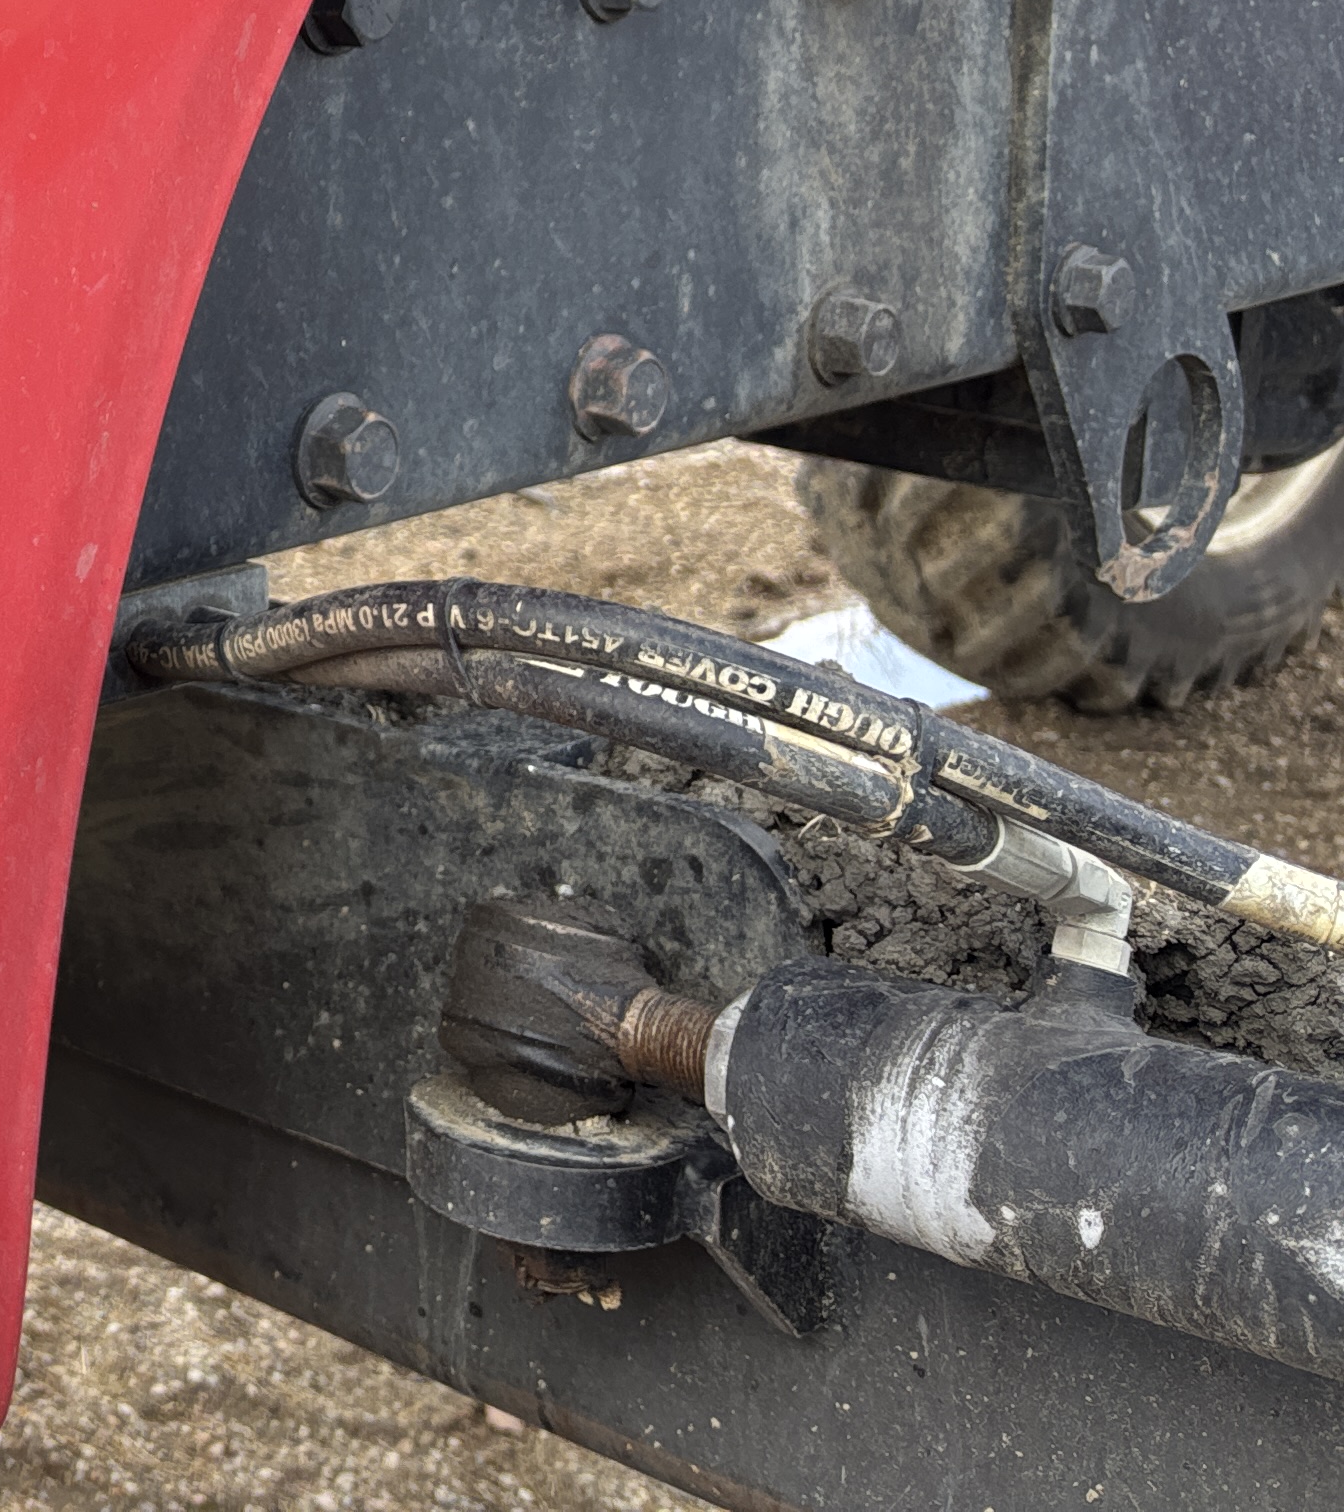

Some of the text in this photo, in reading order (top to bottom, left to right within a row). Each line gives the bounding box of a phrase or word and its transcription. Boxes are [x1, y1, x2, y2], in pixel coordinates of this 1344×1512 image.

[313, 608, 356, 636] MPa
[637, 640, 778, 703] COVER
[785, 686, 914, 756] OUGH
